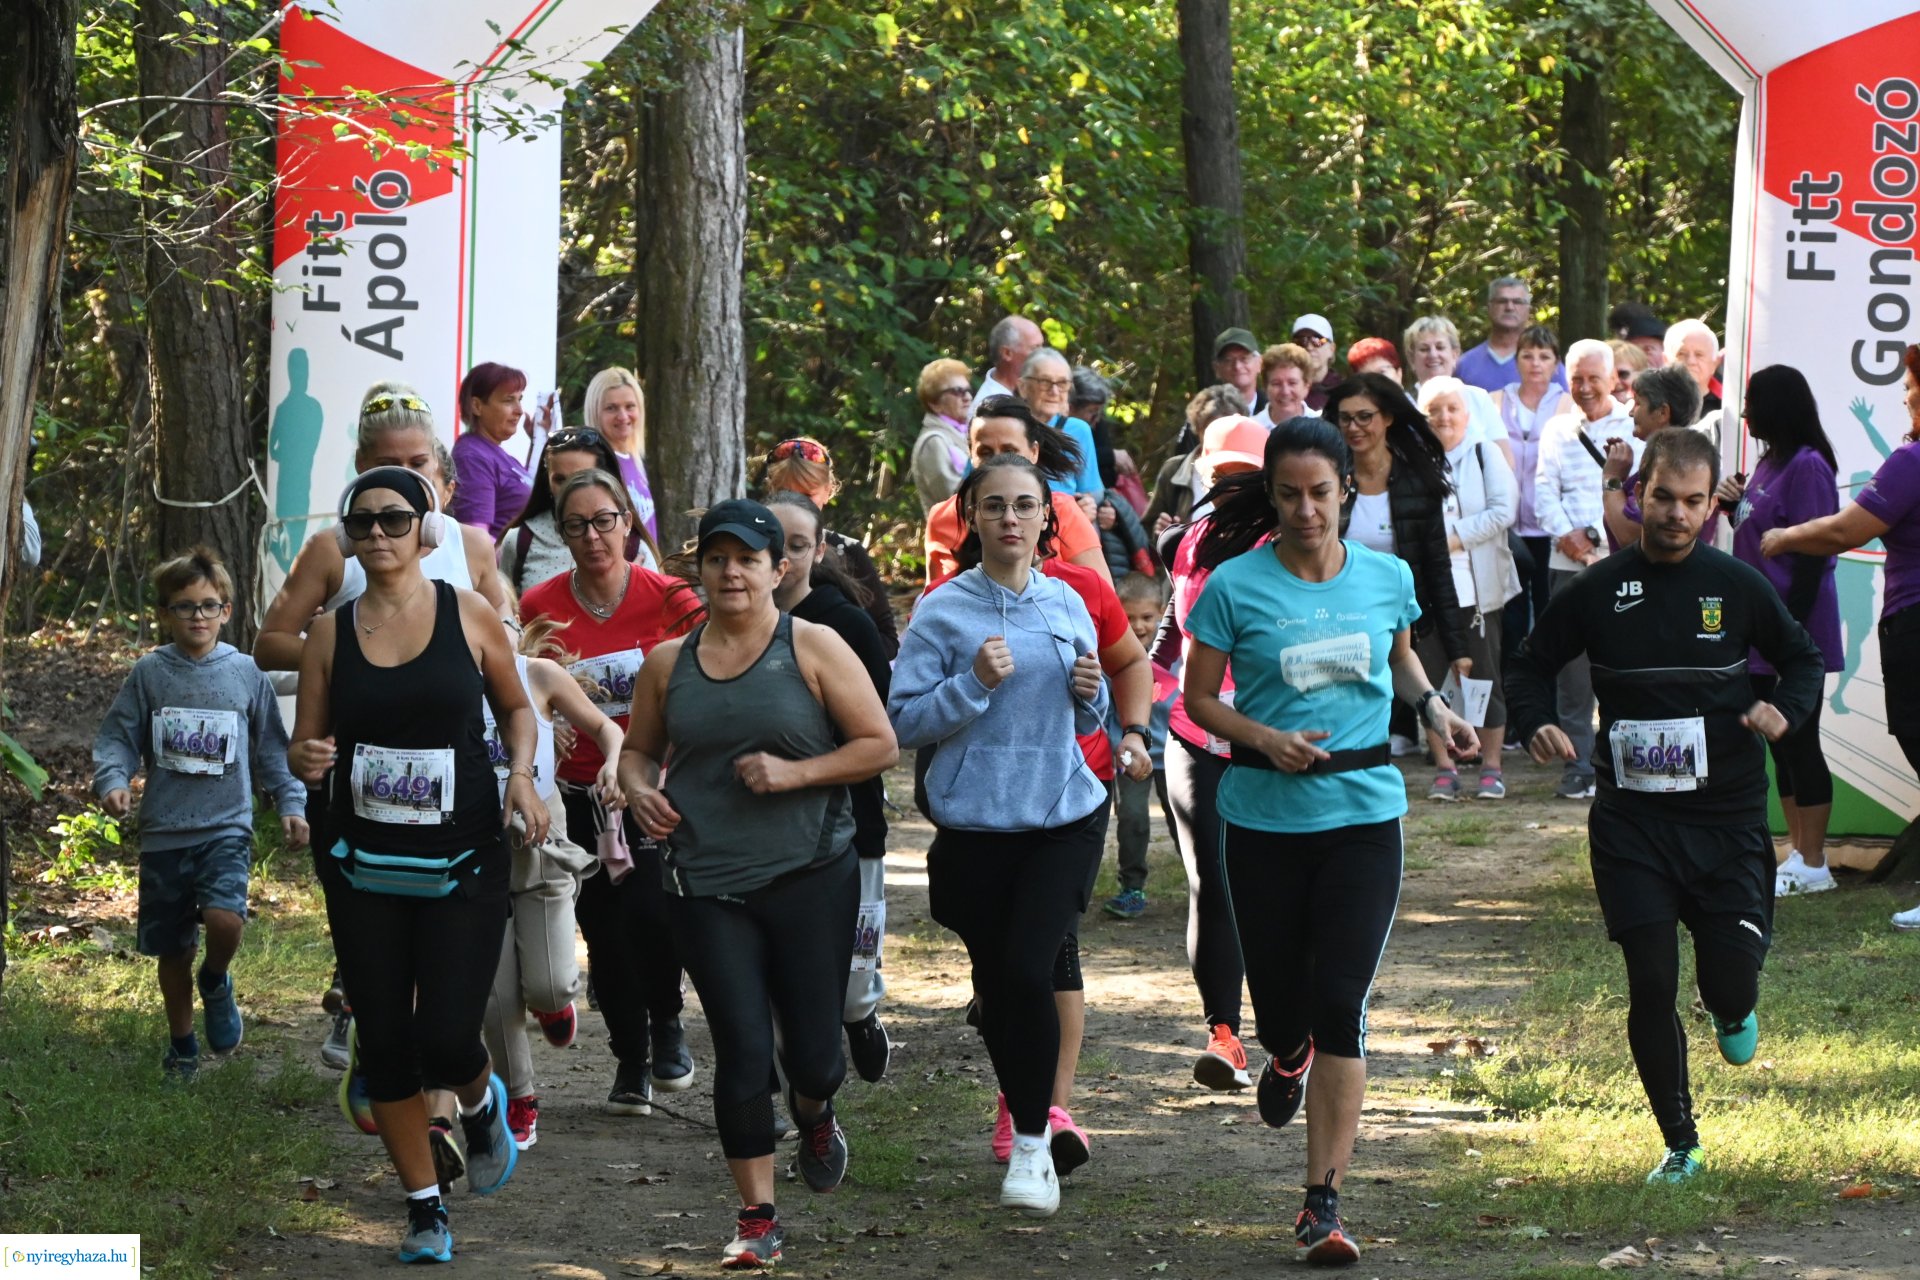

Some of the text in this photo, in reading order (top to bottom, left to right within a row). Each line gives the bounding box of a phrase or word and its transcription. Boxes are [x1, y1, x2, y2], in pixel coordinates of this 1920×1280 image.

[1786, 173, 1841, 281] Fitt
[1851, 78, 1919, 386] Gondozó
[302, 212, 344, 312] Fitt
[341, 171, 419, 361] Ápoló
[1616, 581, 1643, 597] JB
[171, 730, 219, 754] 460
[1632, 744, 1684, 769] 504
[373, 774, 431, 800] 649
